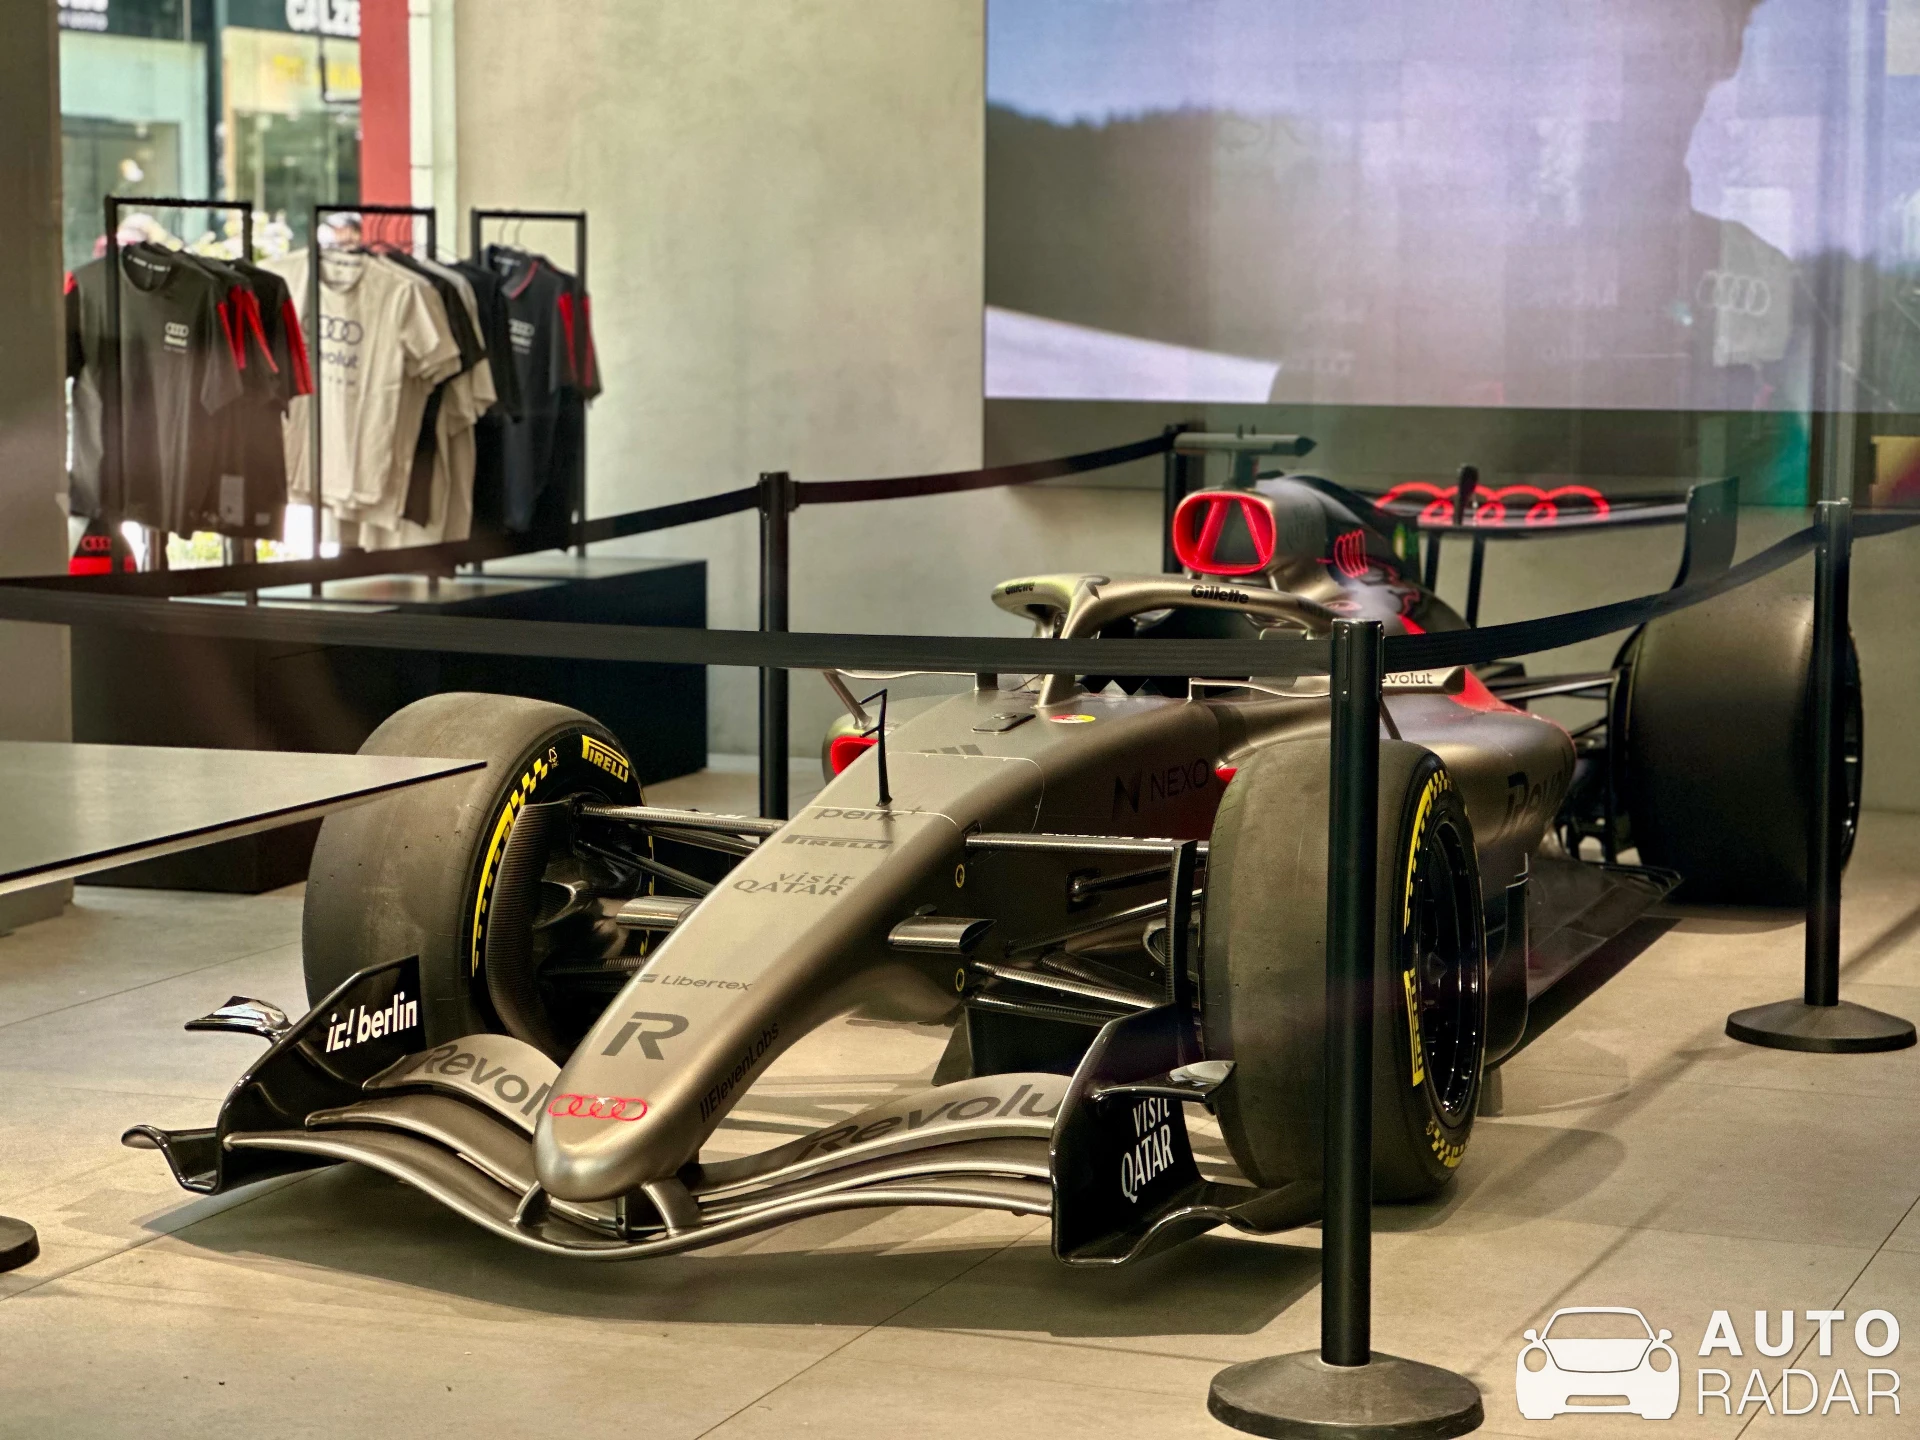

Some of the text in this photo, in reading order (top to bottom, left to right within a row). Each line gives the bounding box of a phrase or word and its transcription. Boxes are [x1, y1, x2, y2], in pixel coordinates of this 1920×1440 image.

[1190, 585, 1249, 605] Gillette
[581, 734, 629, 784] PIRELLI
[1150, 757, 1210, 801] NEXO
[781, 834, 894, 850] PIRELLI
[733, 879, 844, 896] QATAR
[779, 872, 854, 886] visit
[660, 974, 754, 992] Libertex
[356, 991, 418, 1044] berlin
[601, 1011, 690, 1061] R
[404, 1044, 551, 1124] Revol
[1121, 1123, 1175, 1204] QATAR
